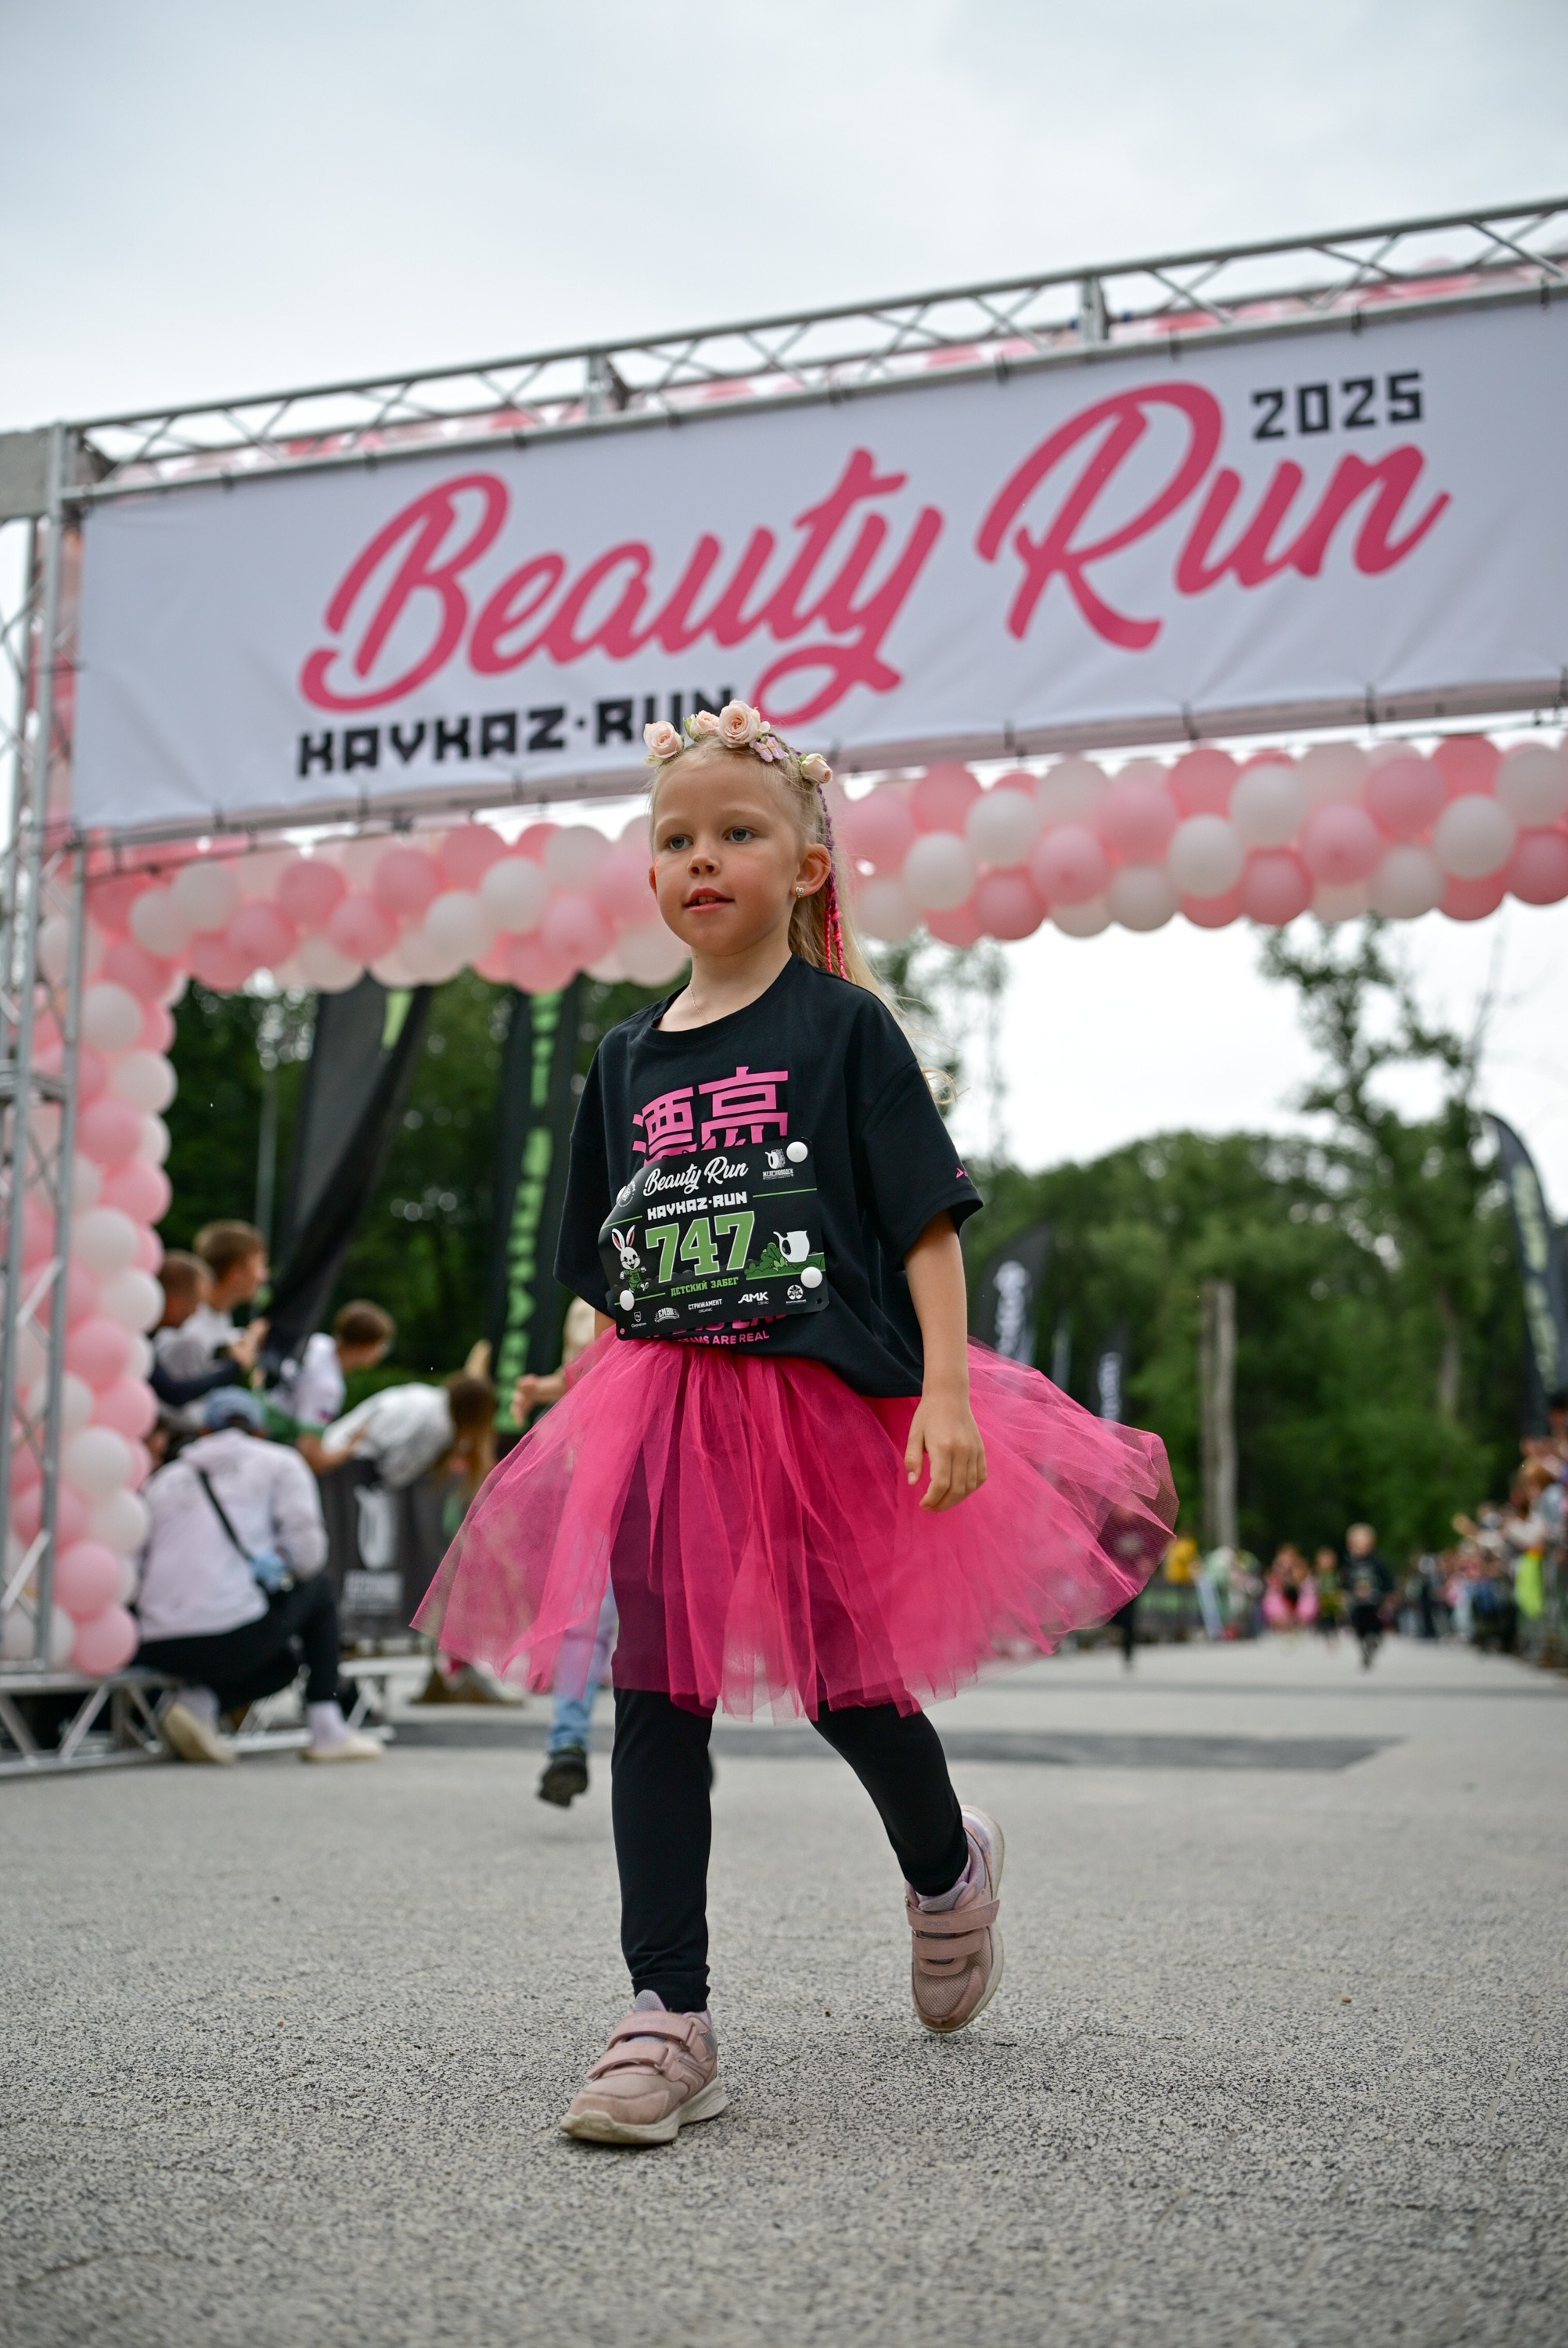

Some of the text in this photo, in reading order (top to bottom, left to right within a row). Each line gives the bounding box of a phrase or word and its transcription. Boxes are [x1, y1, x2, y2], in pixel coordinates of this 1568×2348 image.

[1251, 369, 1425, 441] 2025
[297, 380, 1452, 729] Beauty Run
[643, 1163, 702, 1197] Beauty
[703, 1156, 749, 1184] Run
[645, 1211, 755, 1284] 747
[671, 1277, 739, 1297] ДЕТСКИЙ ЗАБЕГ
[688, 1298, 723, 1310] СТРИЖАМЕНТ
[712, 1335, 737, 1345] ARE
[739, 1331, 770, 1343] REAL
